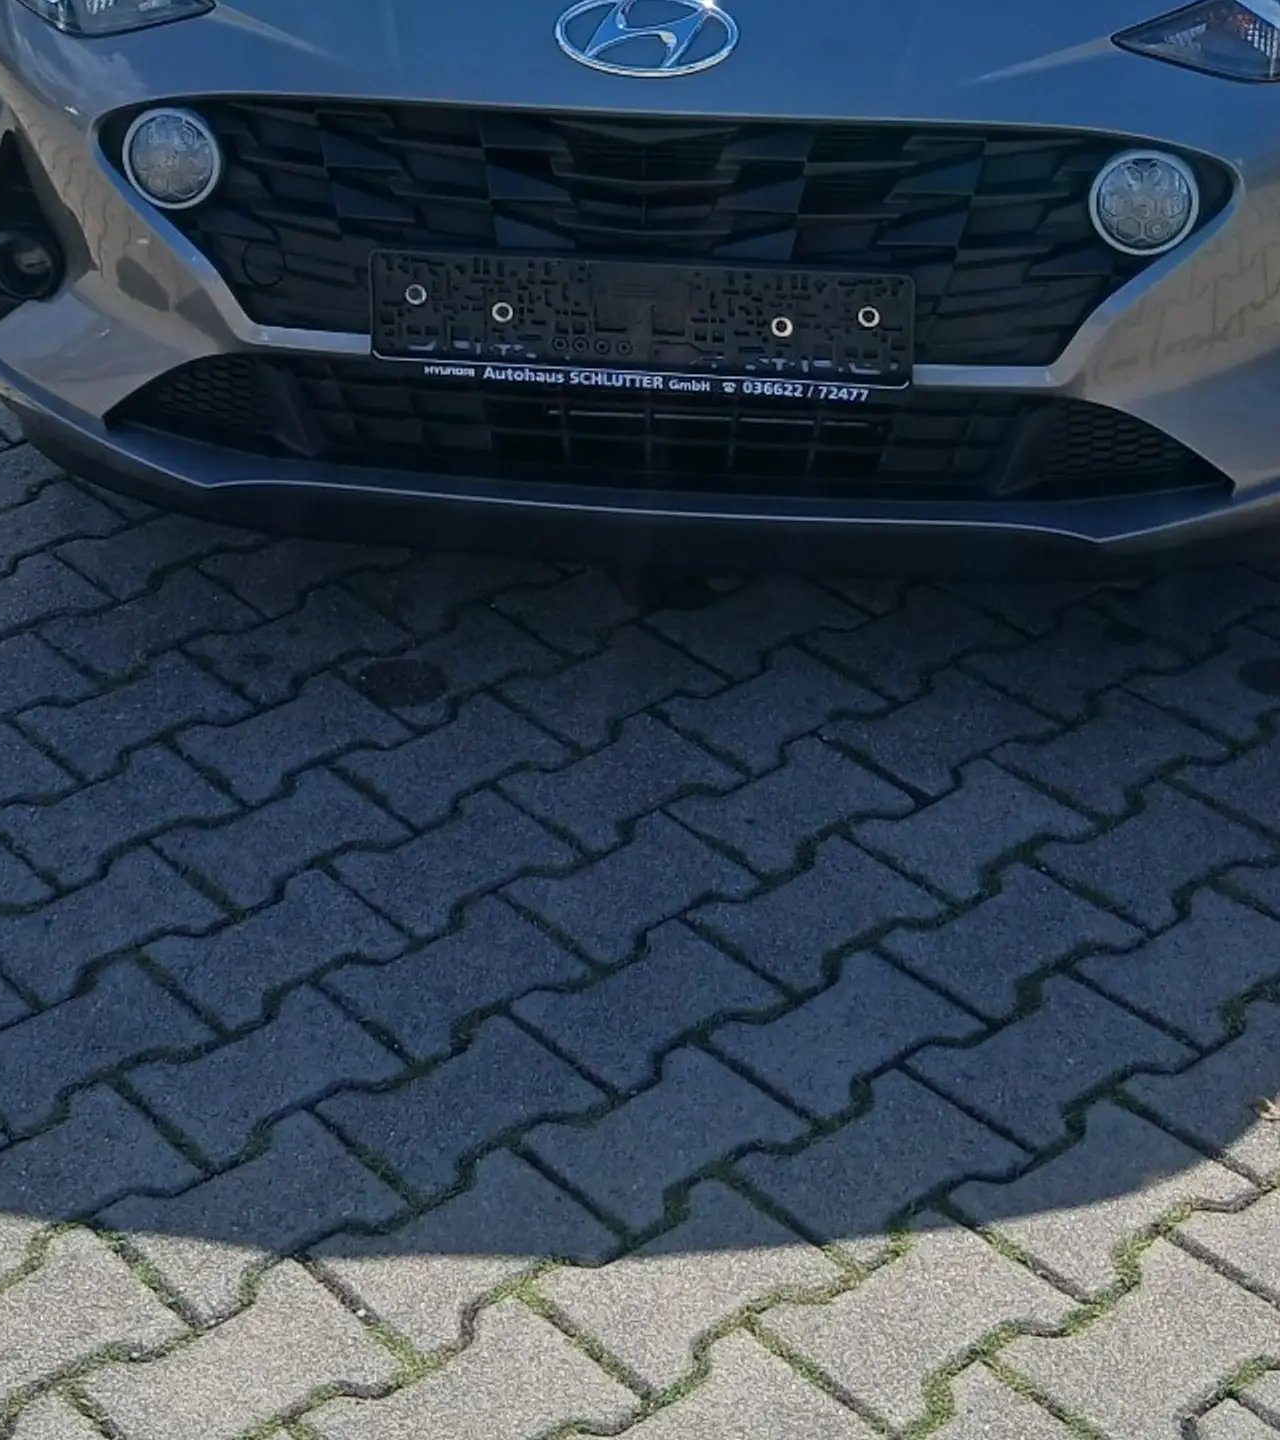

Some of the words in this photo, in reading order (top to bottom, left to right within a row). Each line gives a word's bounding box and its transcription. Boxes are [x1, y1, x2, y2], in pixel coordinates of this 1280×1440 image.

[483, 366, 565, 384] Autohaus
[569, 371, 663, 389] SCHLUTTER
[669, 378, 711, 392] GmbH
[742, 380, 803, 398] 036622
[817, 385, 869, 402] 72477
